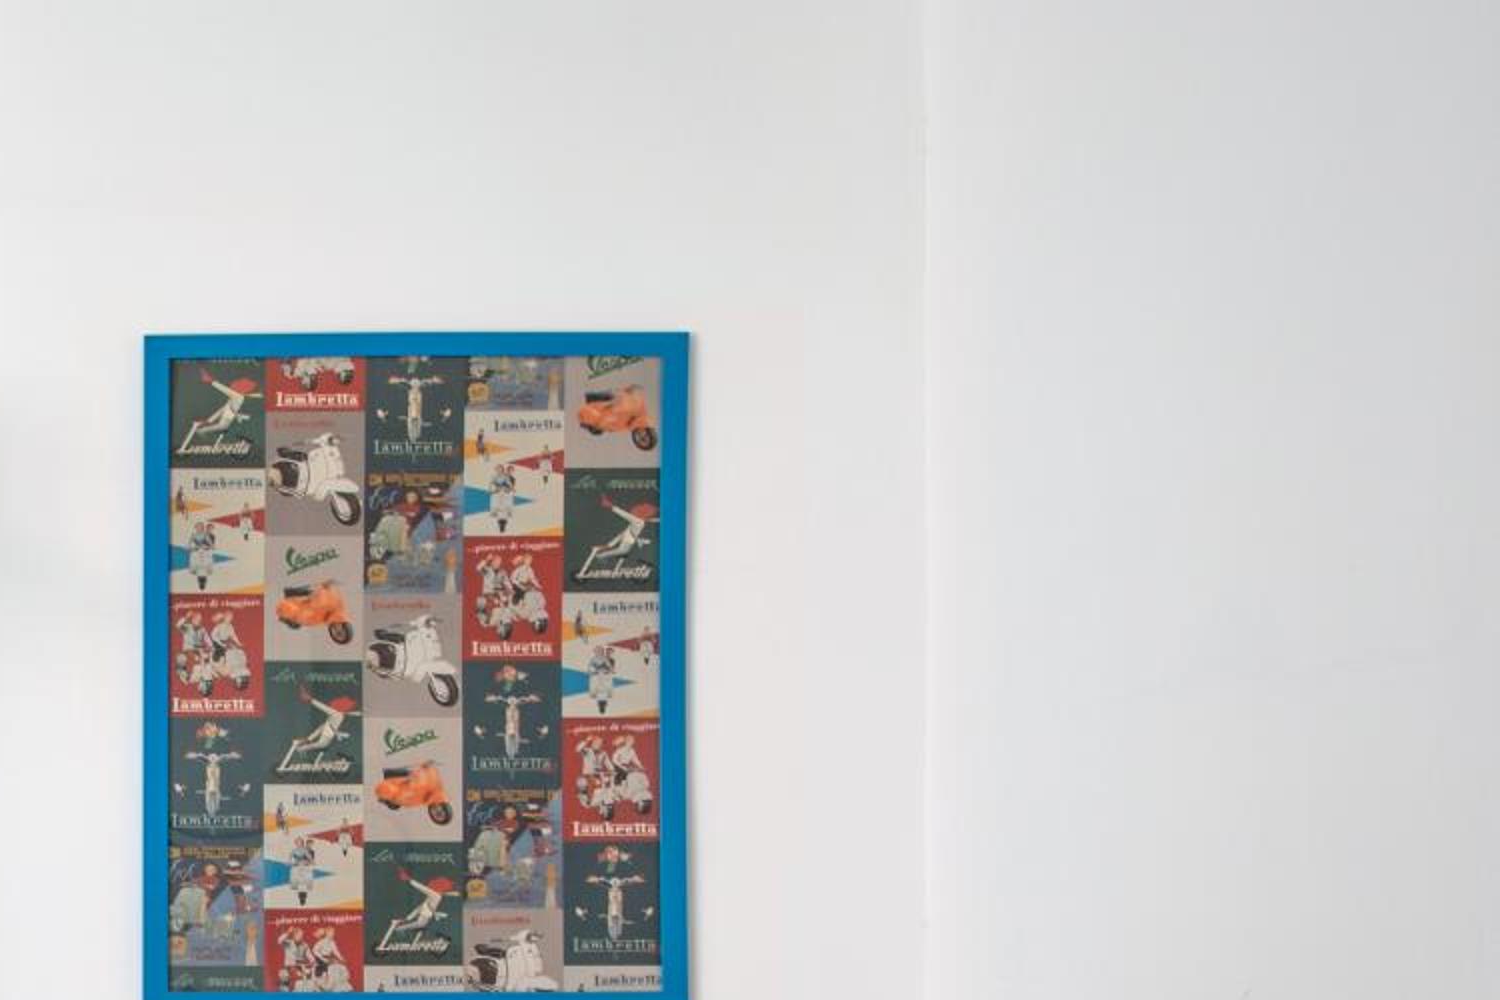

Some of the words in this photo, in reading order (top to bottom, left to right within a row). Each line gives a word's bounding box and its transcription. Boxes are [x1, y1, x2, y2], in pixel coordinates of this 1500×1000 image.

[276, 391, 359, 407] Lambretta
[493, 418, 563, 432] Lambretta
[193, 475, 263, 490] Lambretta
[471, 641, 552, 657] Lambretta
[172, 697, 254, 712] Lambretta
[293, 793, 360, 806] Lambretta
[573, 820, 657, 837] Lambretta
[394, 974, 464, 986] Lambretta
